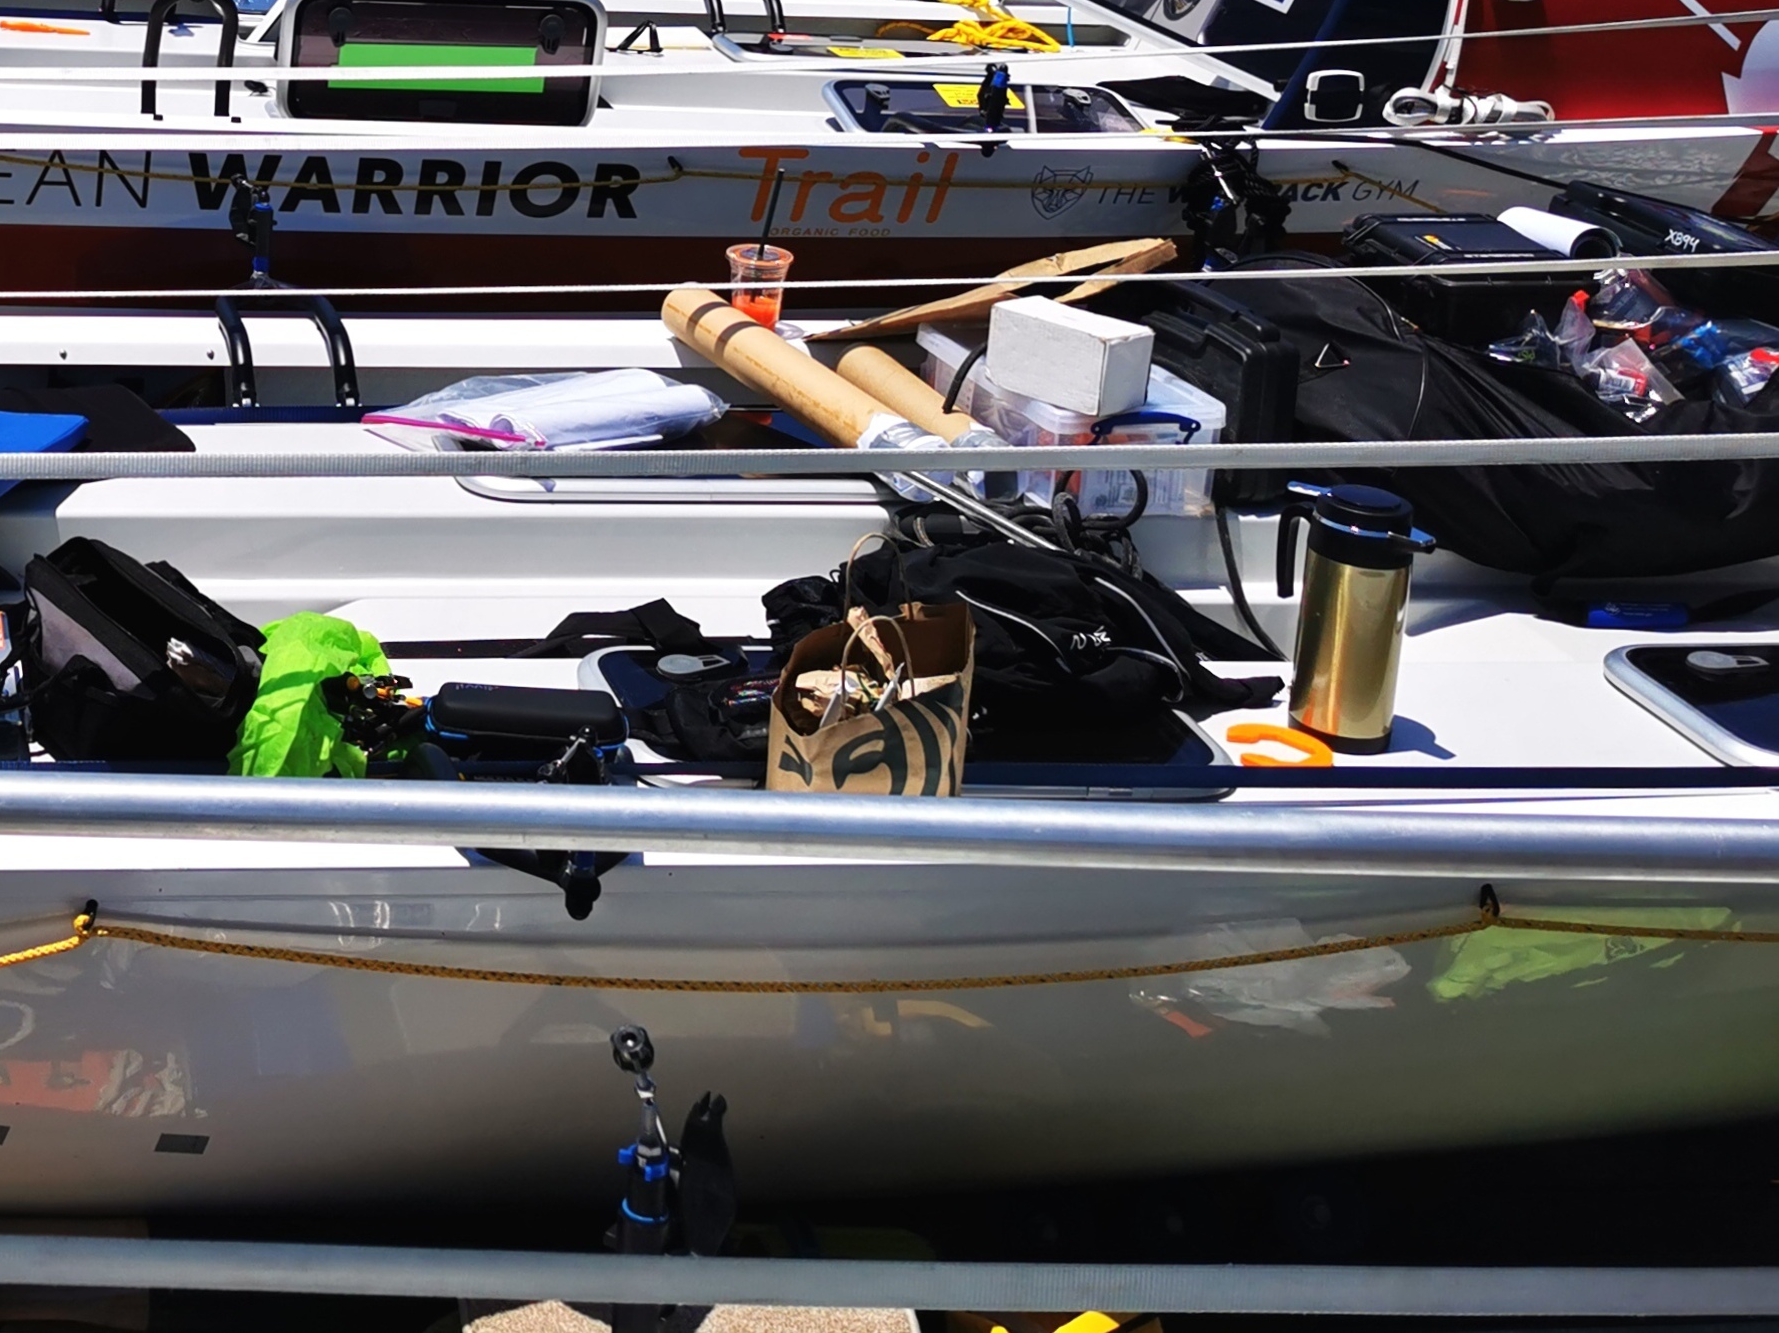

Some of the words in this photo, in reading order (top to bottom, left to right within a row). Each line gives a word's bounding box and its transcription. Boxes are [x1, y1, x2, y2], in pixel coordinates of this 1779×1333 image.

[188, 152, 642, 219] WARRIOR
[738, 147, 960, 224] Trail
[1098, 186, 1157, 205] THE
[1351, 179, 1422, 202] GYM
[848, 228, 892, 238] FOOD
